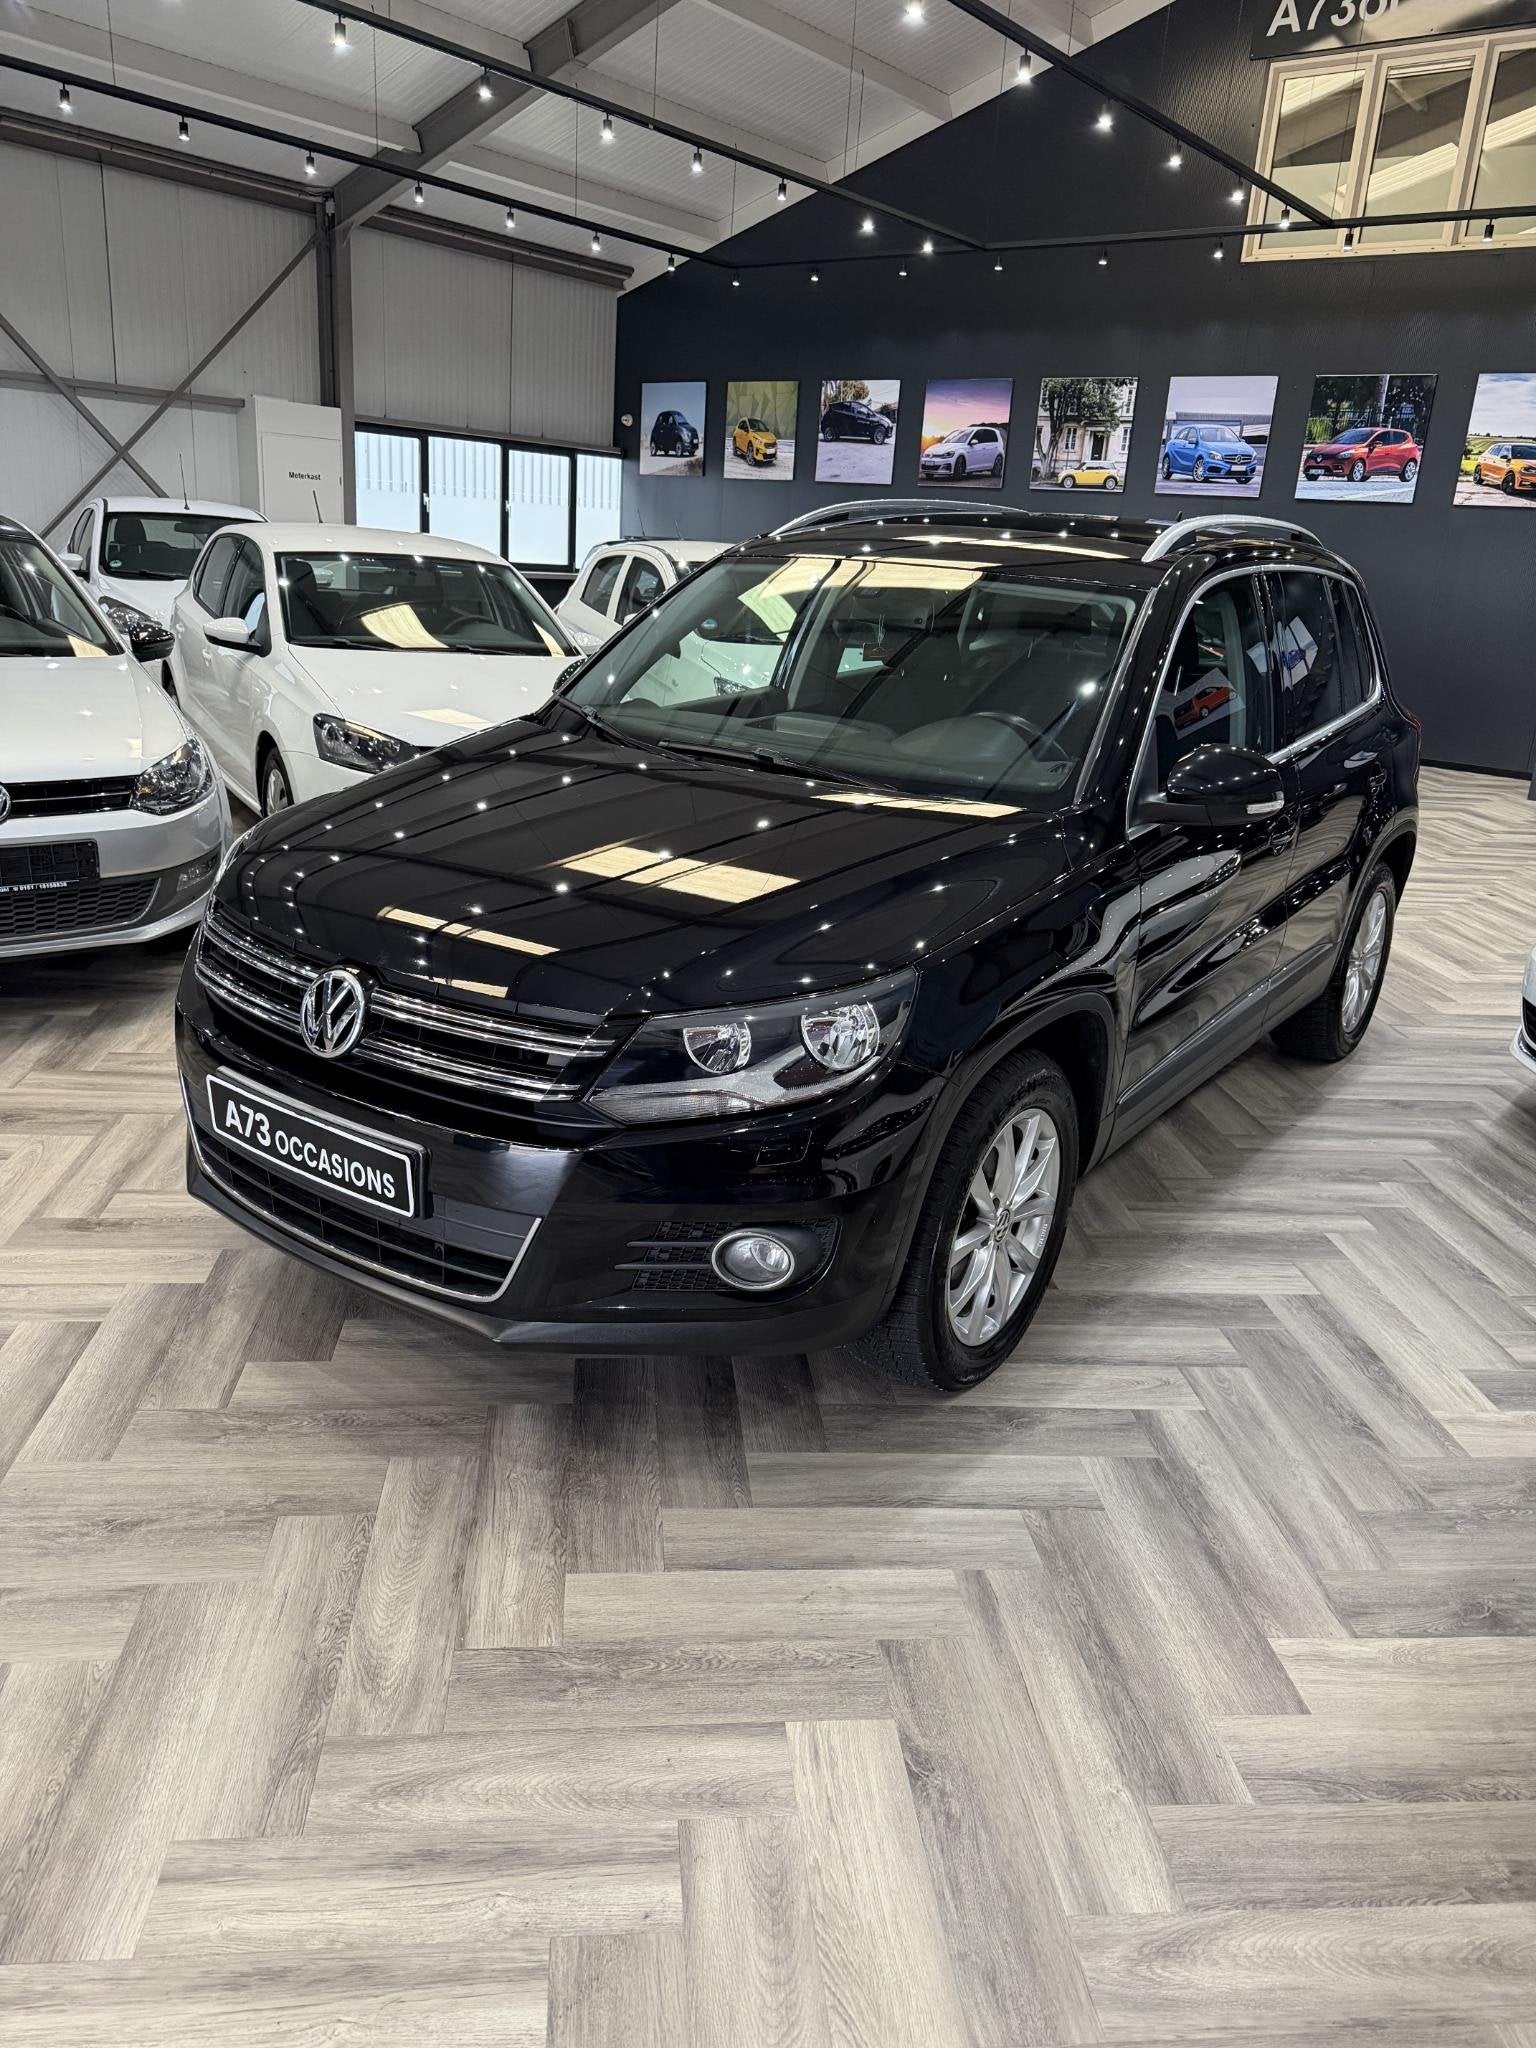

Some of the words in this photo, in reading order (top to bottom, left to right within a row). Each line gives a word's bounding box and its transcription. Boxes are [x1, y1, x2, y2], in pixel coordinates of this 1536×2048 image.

[288, 471, 321, 481] Meterkast
[225, 1099, 271, 1147] A73
[274, 1130, 396, 1199] OCCASIONS
